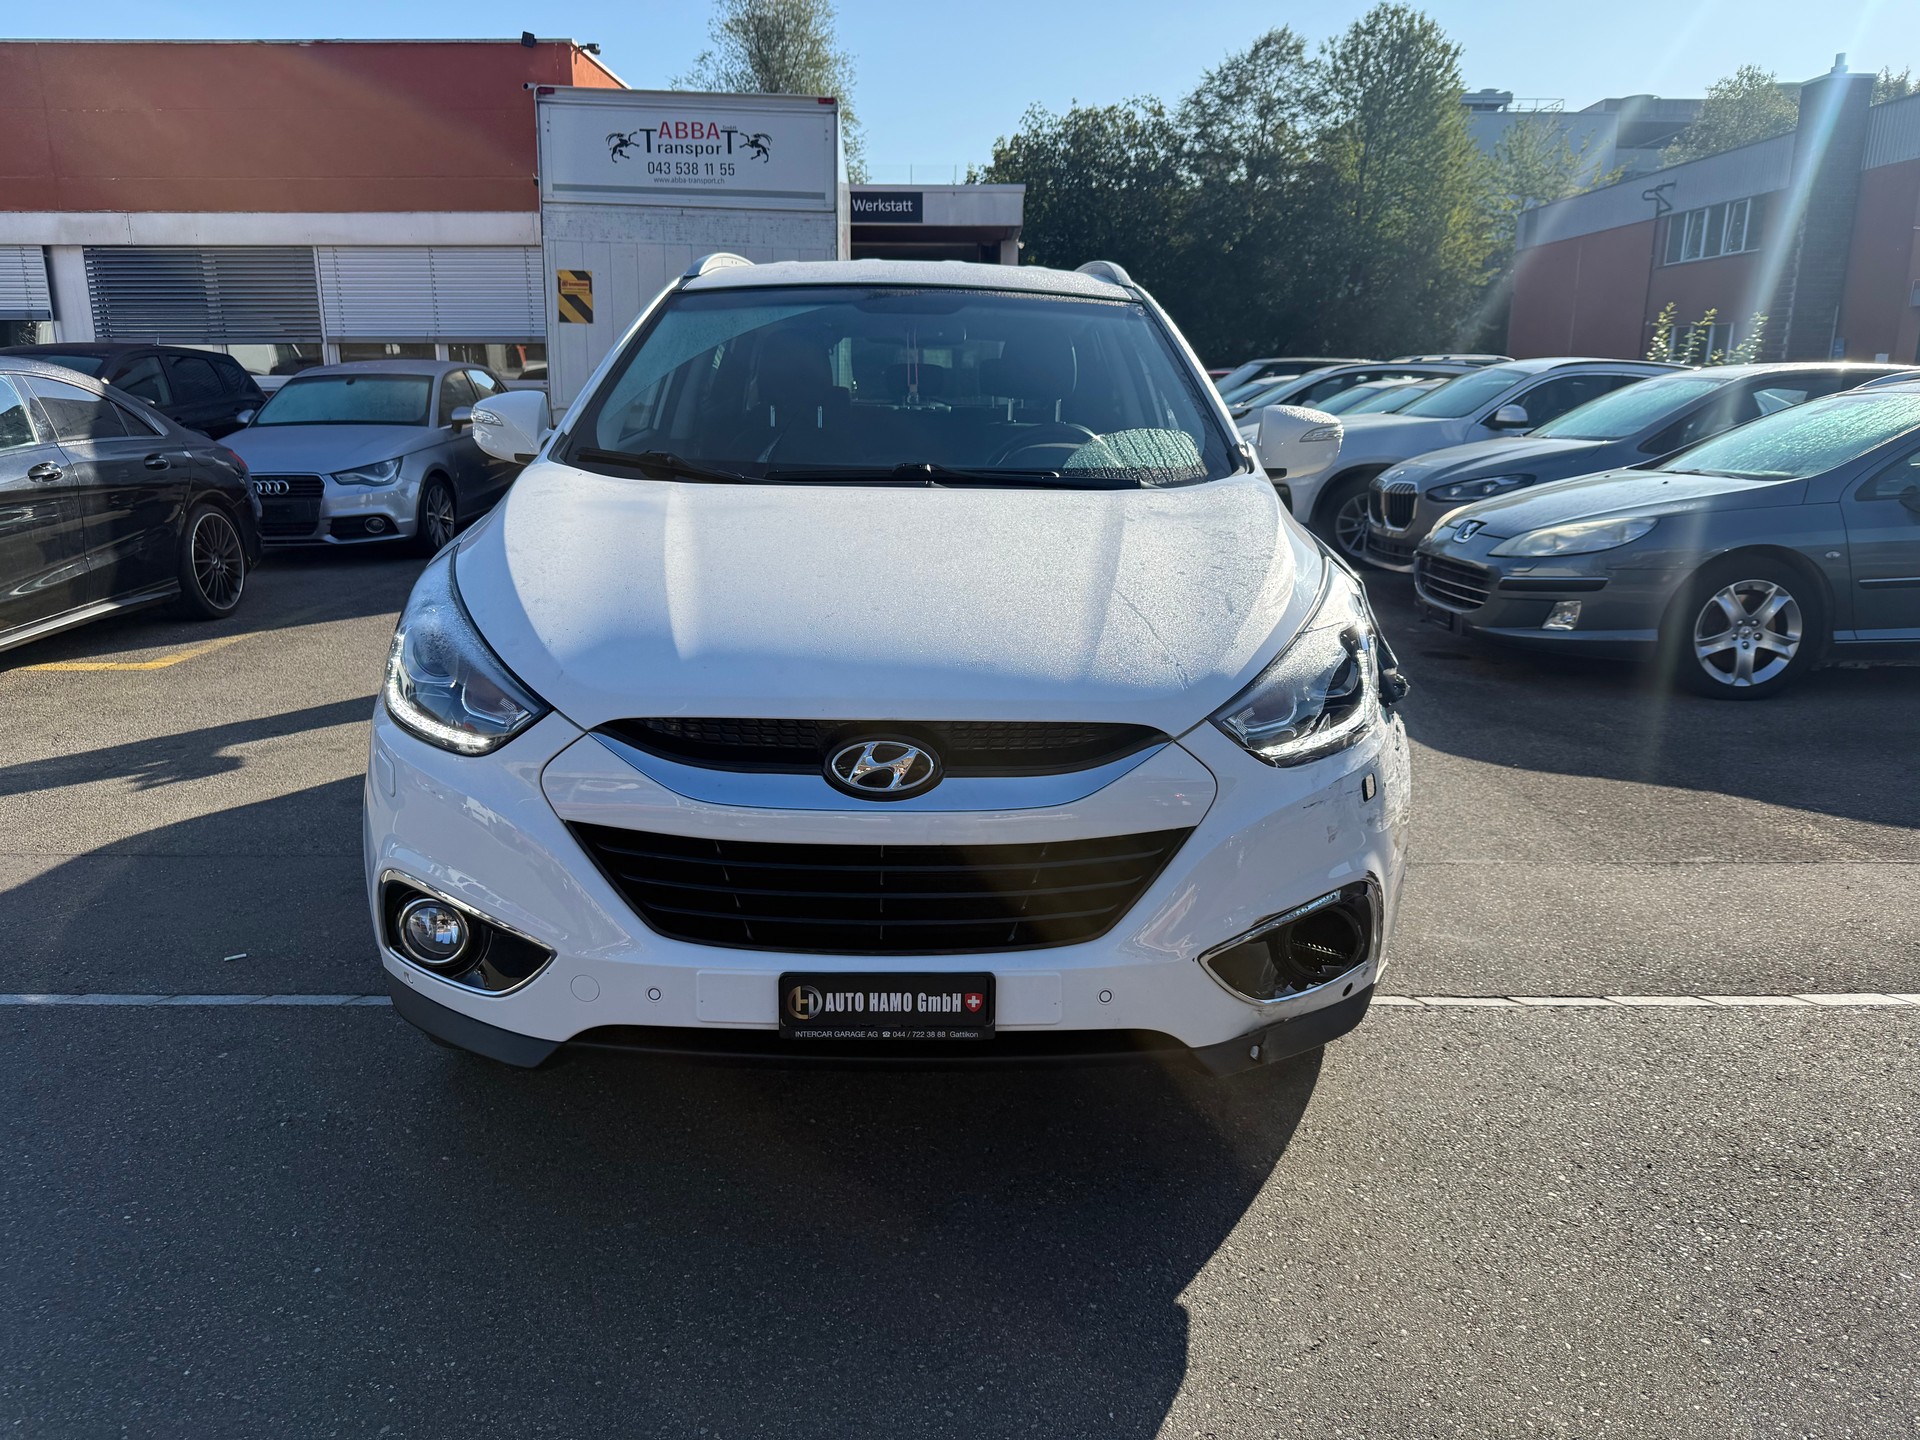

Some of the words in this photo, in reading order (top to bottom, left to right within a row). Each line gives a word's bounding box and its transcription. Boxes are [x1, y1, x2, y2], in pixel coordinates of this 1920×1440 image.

[658, 121, 720, 140] ABBA
[647, 161, 671, 175] 043
[675, 162, 699, 176] 538
[704, 163, 714, 176] 11
[719, 163, 735, 176] 55
[654, 176, 725, 185] www.abba-transport.ch
[852, 198, 913, 212] Werkstatt
[824, 991, 865, 1012] AUTO
[869, 992, 913, 1012] HAMO
[917, 992, 962, 1013] GmbH
[795, 1030, 833, 1038] INTERCAR
[834, 1030, 866, 1038] GARAGE
[867, 1030, 879, 1038] AG
[949, 1030, 979, 1038] Gattikon
